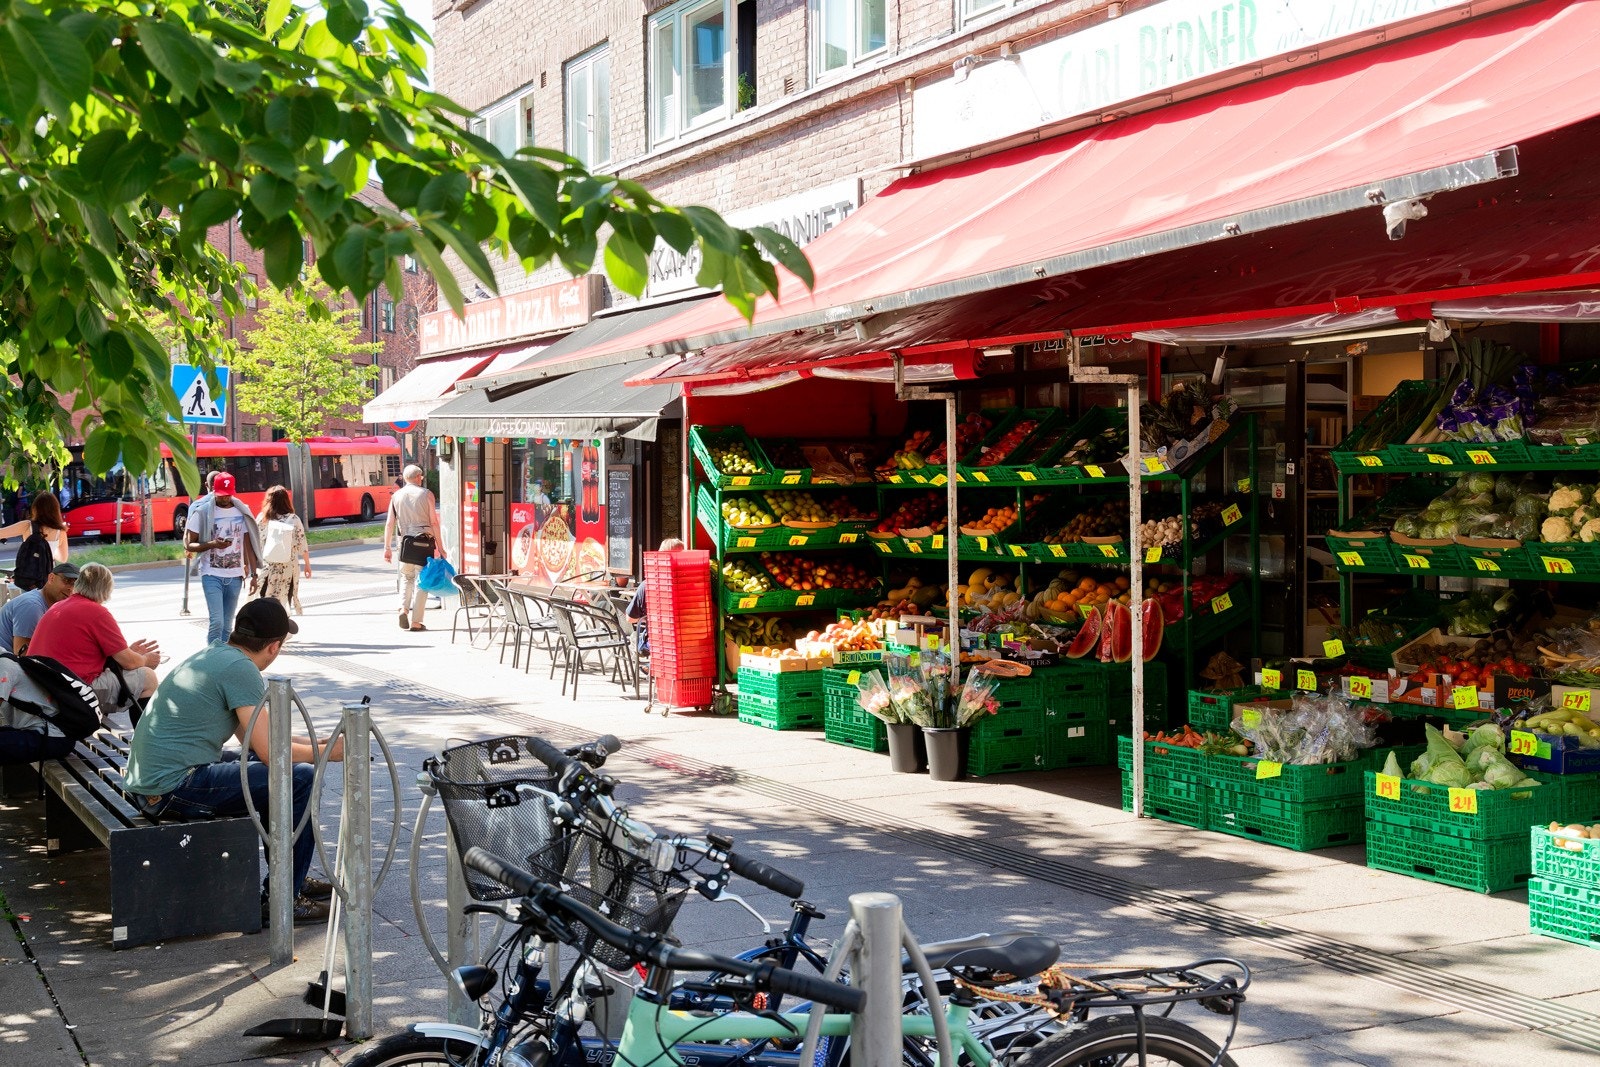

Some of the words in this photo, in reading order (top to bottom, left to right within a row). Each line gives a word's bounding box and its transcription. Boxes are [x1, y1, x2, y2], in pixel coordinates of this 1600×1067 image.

[443, 308, 501, 346] FAVORIT
[505, 296, 553, 338] PIZZA
[1548, 561, 1564, 574] 19
[1036, 658, 1051, 666] FIGS
[1351, 681, 1366, 695] 24
[1508, 686, 1536, 699] presty
[1563, 694, 1584, 709] 64
[1513, 737, 1531, 754] 24
[1381, 781, 1392, 796] 19
[1452, 795, 1471, 810] 24
